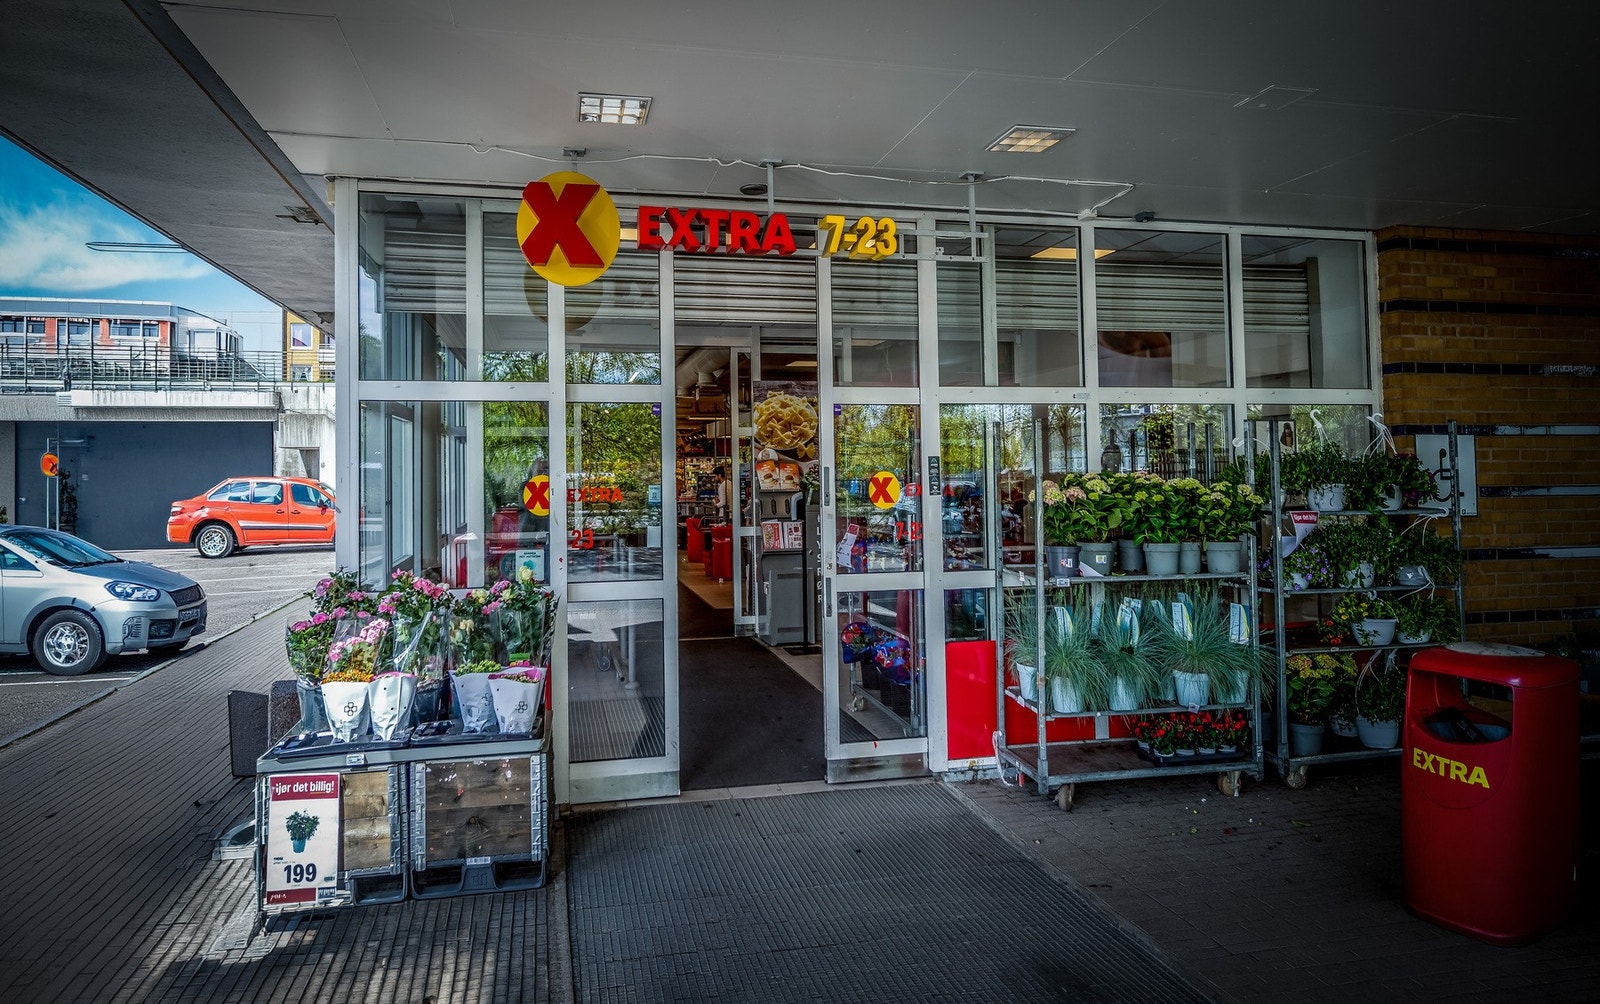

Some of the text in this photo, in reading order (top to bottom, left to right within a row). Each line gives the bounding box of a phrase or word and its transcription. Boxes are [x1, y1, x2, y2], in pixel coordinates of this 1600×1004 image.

[522, 181, 898, 269] X EXTRA 7-23
[524, 481, 624, 510] X EXTRA
[870, 477, 896, 504] X
[571, 528, 595, 550] 23
[1412, 746, 1491, 790] EXTRA
[293, 781, 309, 793] det
[310, 780, 335, 795] billig!
[284, 862, 318, 884] 199
